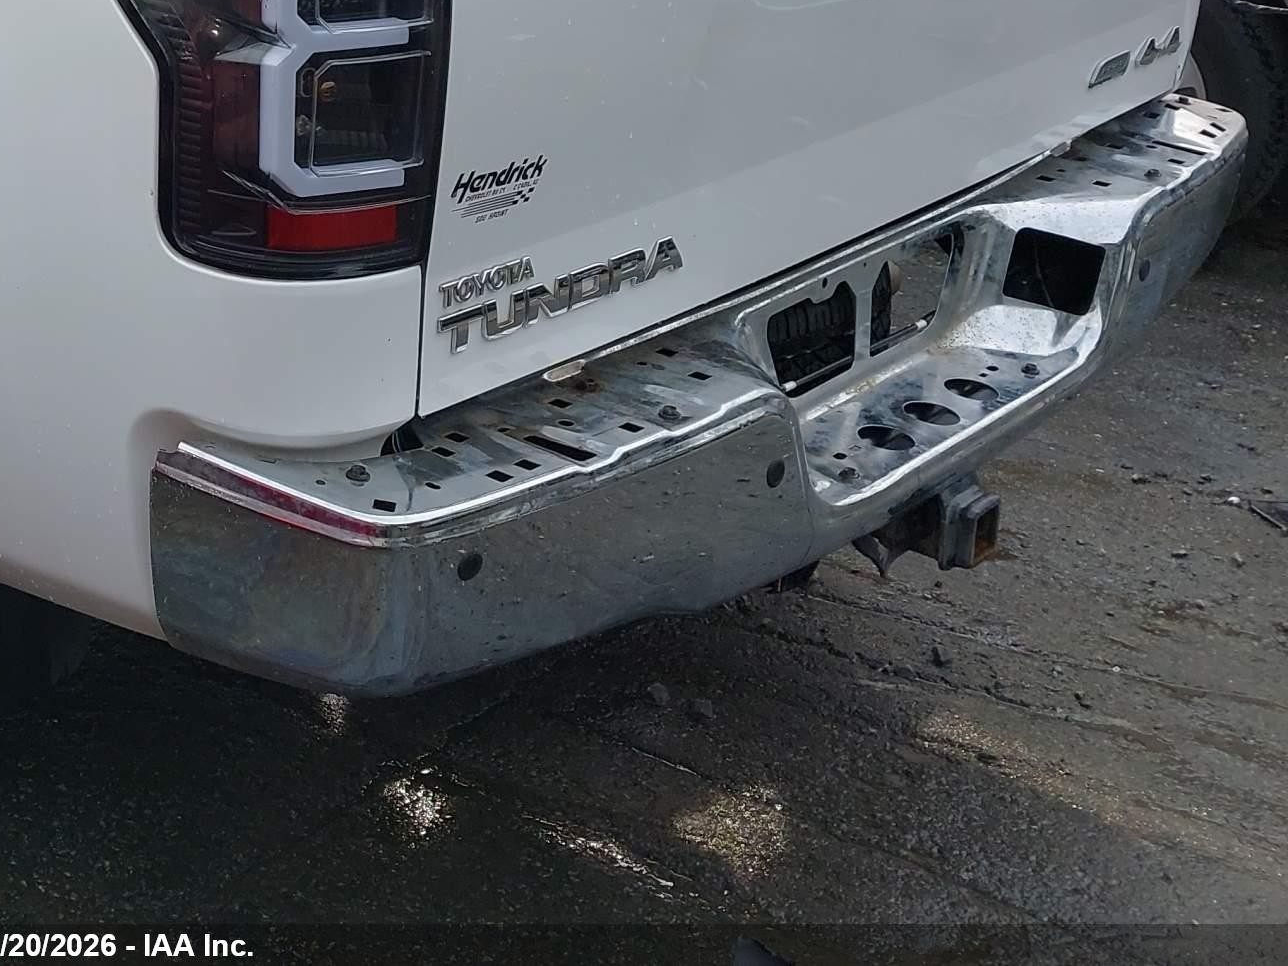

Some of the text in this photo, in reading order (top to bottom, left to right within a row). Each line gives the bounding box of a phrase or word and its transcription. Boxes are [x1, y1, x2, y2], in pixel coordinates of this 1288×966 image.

[450, 155, 548, 204] Hendrick
[437, 235, 685, 354] TUNDRA
[439, 255, 535, 308] TOYOTA
